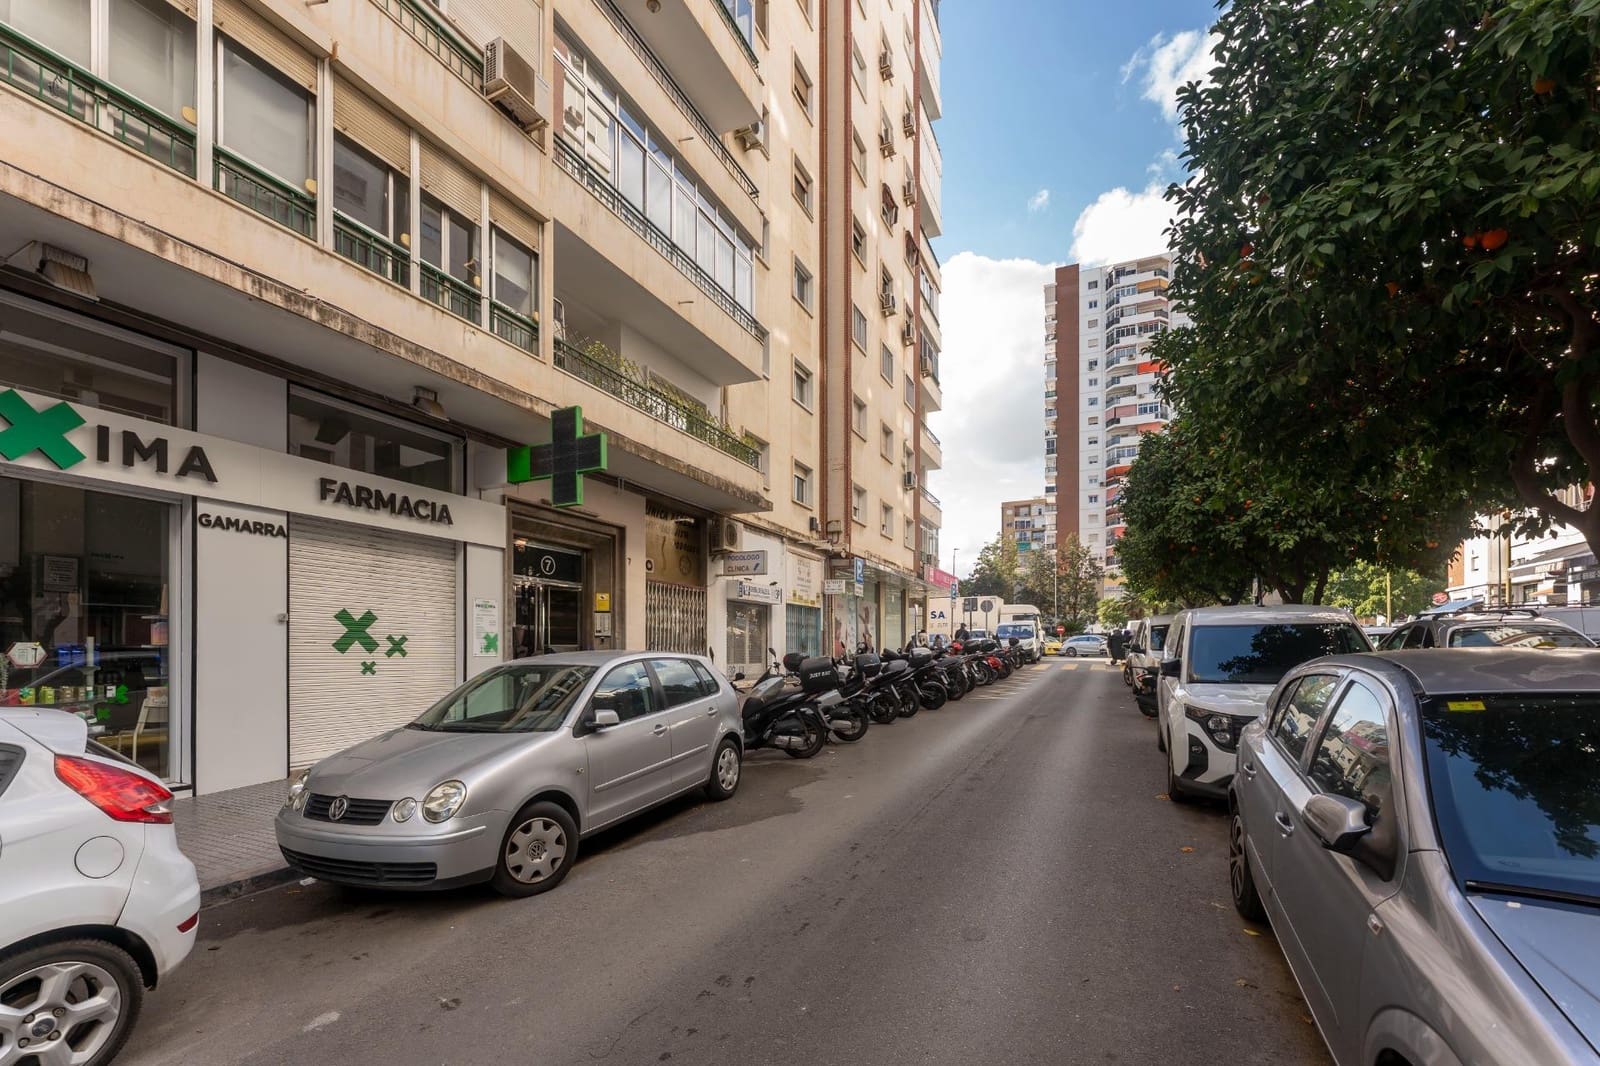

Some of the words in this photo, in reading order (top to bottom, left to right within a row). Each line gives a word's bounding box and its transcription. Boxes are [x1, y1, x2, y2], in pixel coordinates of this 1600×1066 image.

[319, 476, 453, 525] FARMACIA
[198, 513, 287, 538] GAMARRA
[544, 559, 552, 571] 7
[930, 611, 945, 619] SA
